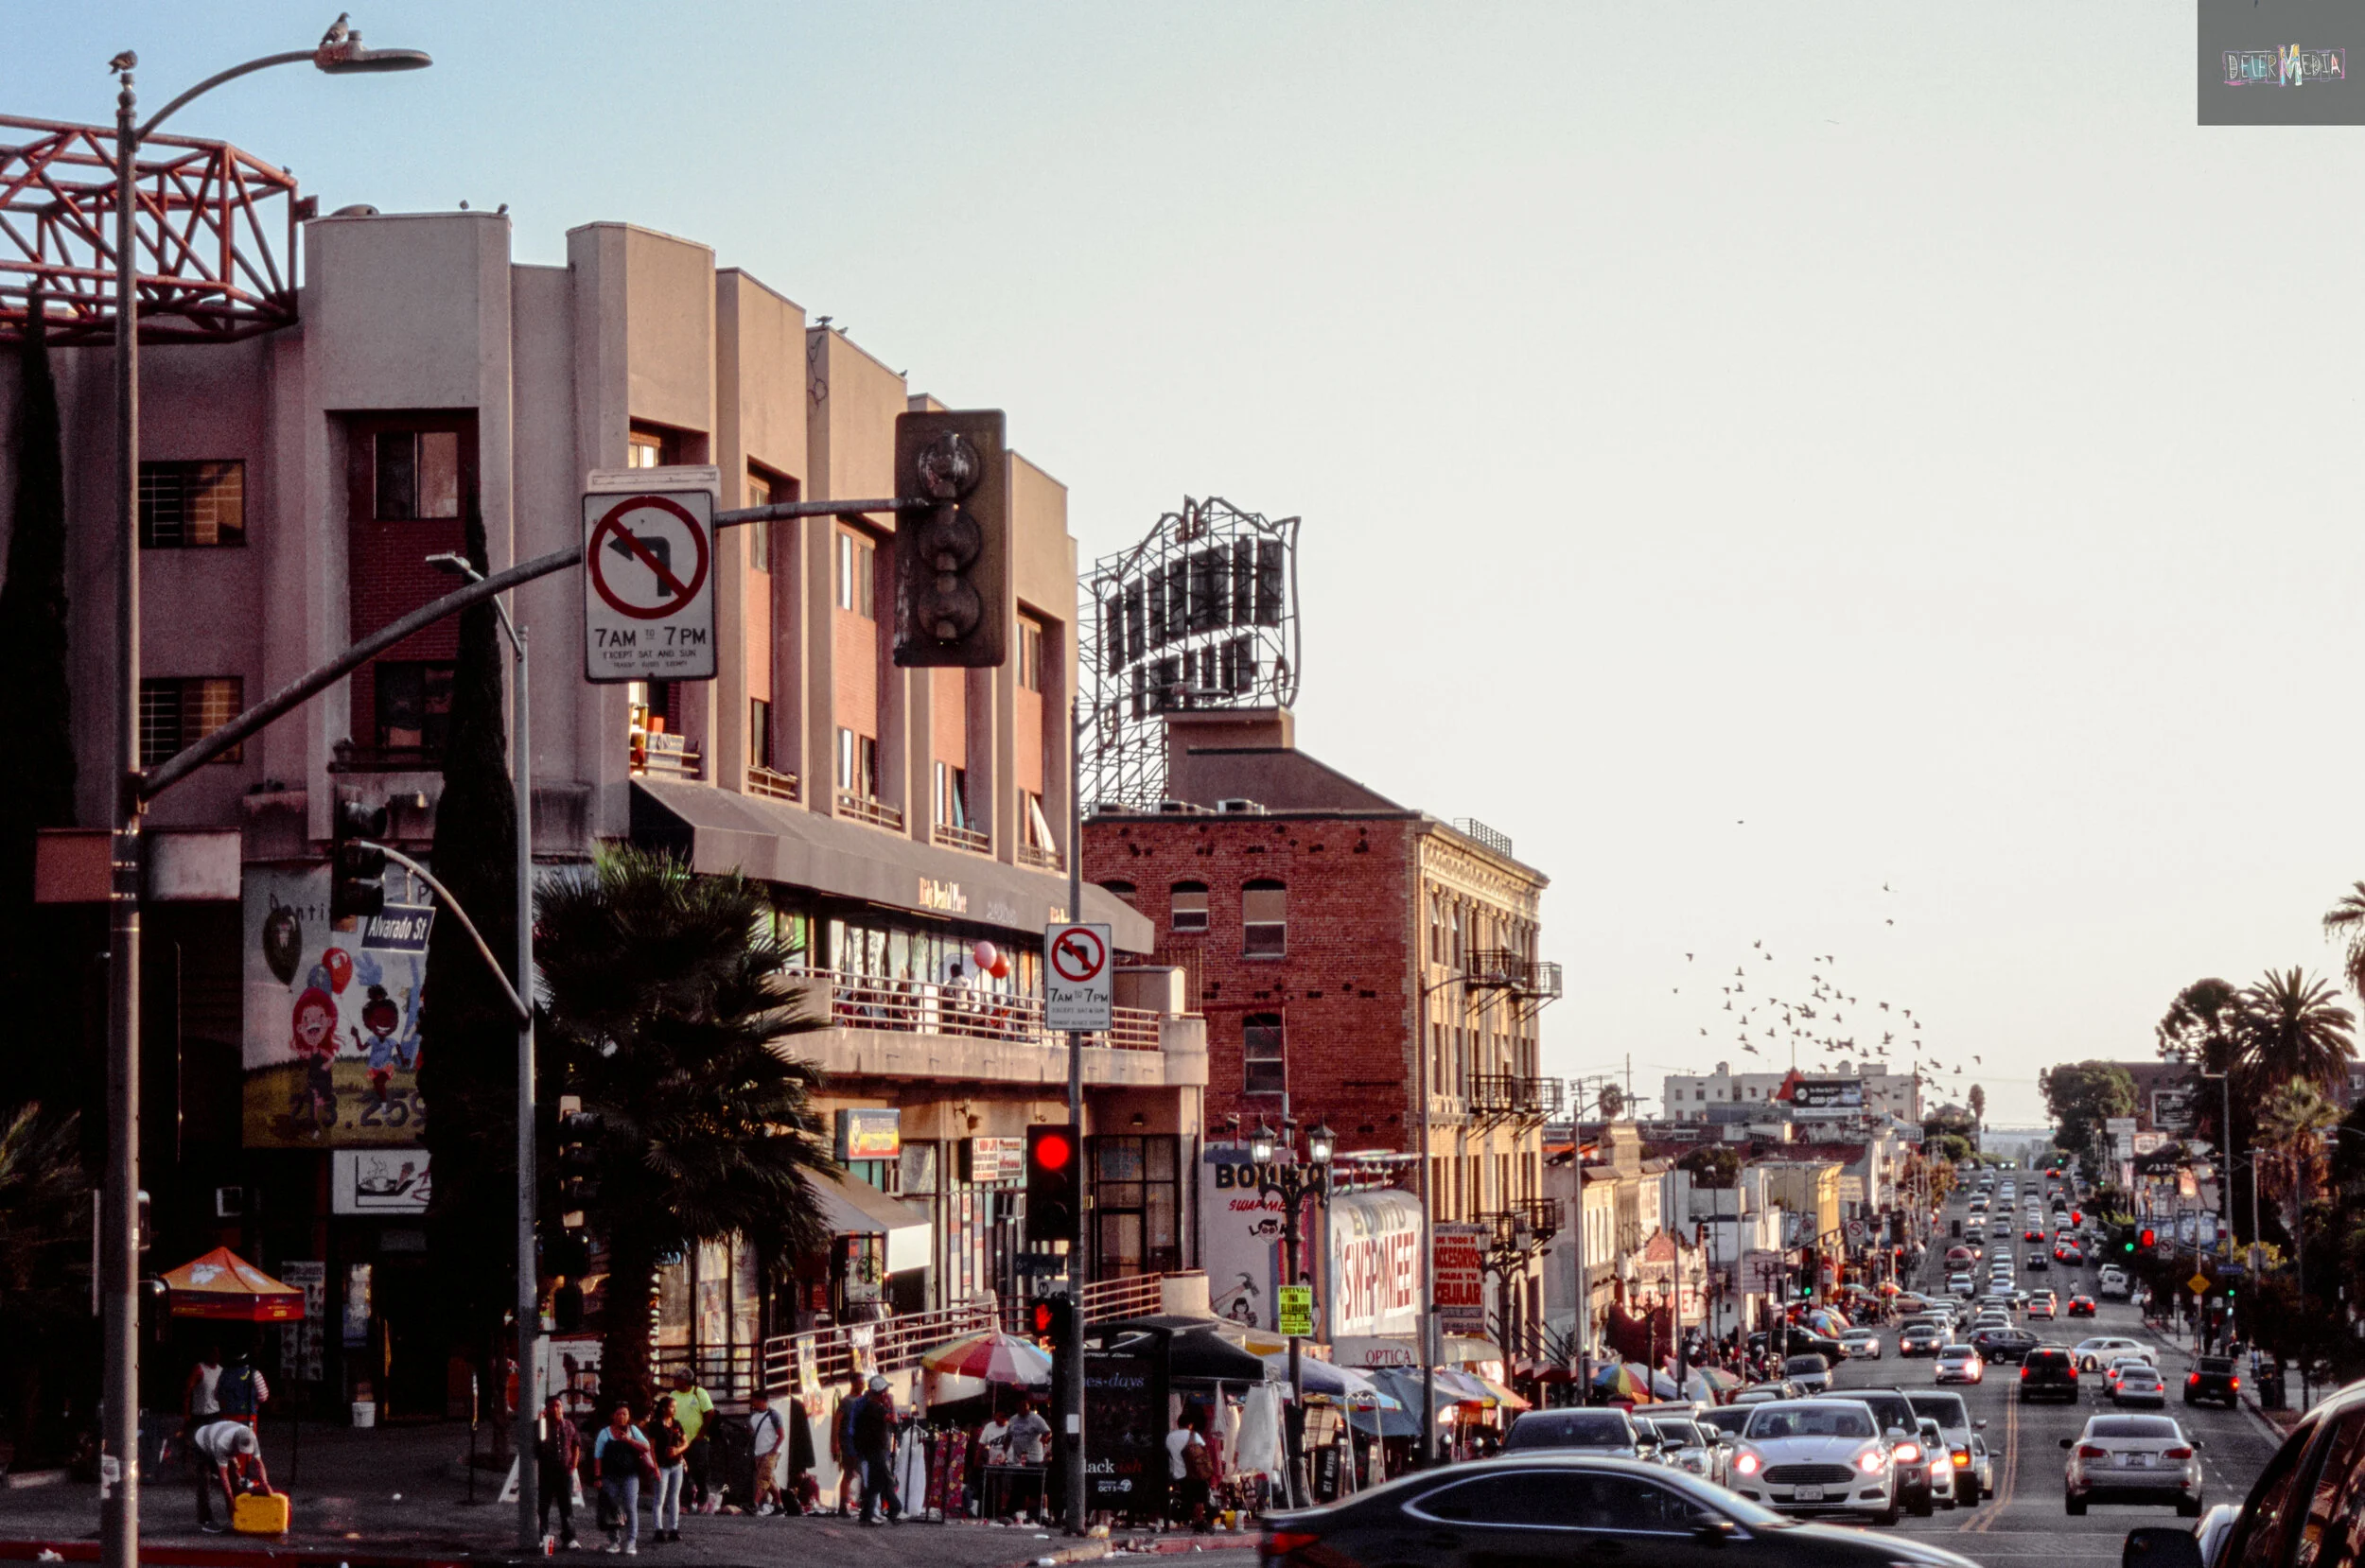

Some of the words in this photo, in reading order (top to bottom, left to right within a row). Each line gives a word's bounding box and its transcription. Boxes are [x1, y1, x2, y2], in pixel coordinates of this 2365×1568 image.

[603, 651, 633, 659] EXCEPT
[639, 650, 653, 658] SAT
[657, 649, 674, 657] AND
[680, 649, 697, 657] SUN
[367, 916, 411, 940] Alvarado
[413, 915, 427, 940] St
[1229, 1199, 1263, 1211] SWAP
[1345, 1239, 1378, 1321] SWAP
[1384, 1232, 1415, 1310] MEET
[1438, 1272, 1463, 1281] PARA
[1466, 1272, 1478, 1281] TU
[1435, 1282, 1481, 1305] CELULAR
[1365, 1348, 1412, 1366] OPTICA
